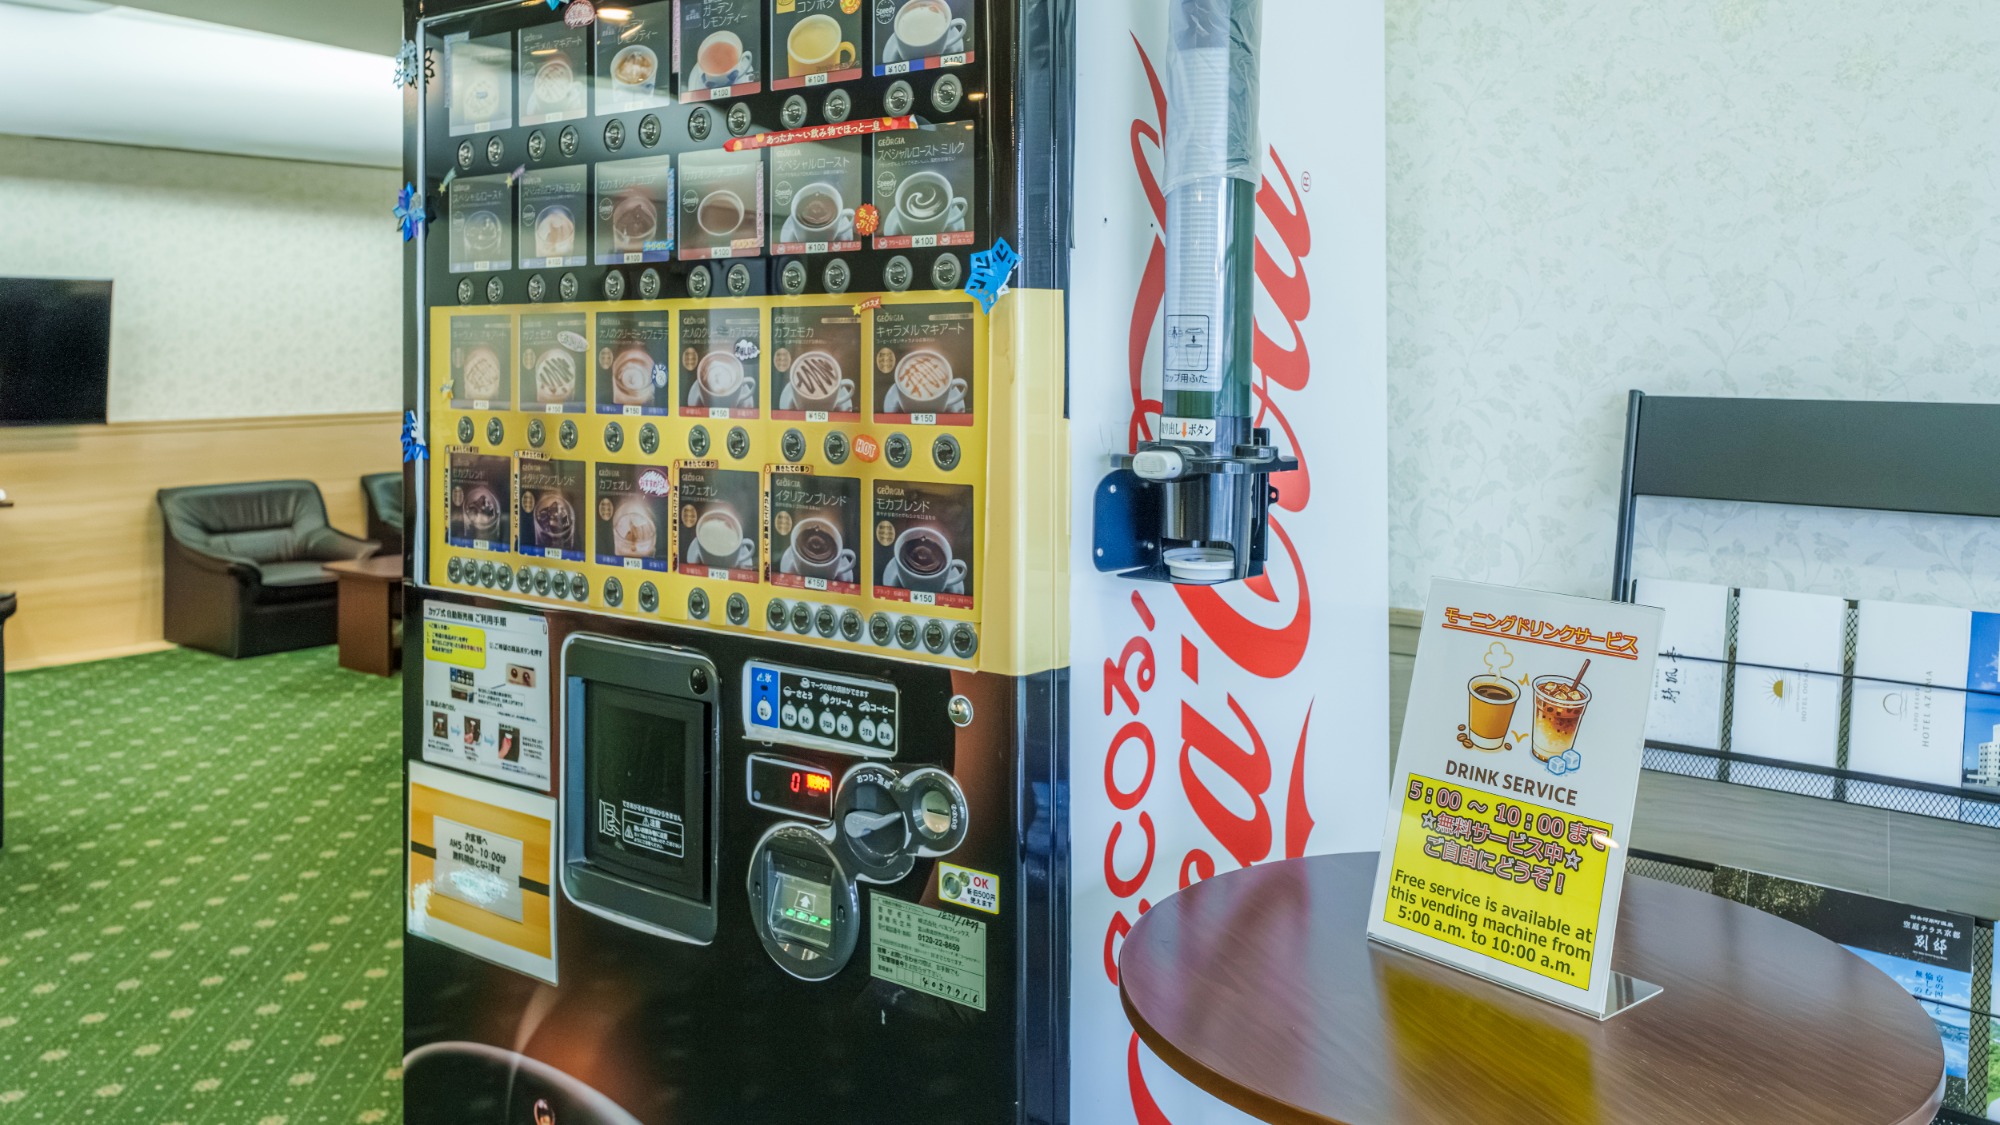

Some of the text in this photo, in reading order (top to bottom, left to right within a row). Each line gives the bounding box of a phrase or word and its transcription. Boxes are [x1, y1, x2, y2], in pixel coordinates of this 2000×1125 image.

[702, 11, 748, 29] レモンティー
[888, 64, 906, 73] ¥100
[807, 75, 825, 83] ¥100
[713, 88, 729, 96] ¥100
[775, 156, 850, 171] スペシャルロースト
[808, 243, 825, 251] ¥100
[914, 237, 934, 246] ¥100
[775, 327, 814, 338] カフェモカ
[711, 410, 727, 418] ¥150
[809, 412, 826, 421] ¥150
[914, 414, 934, 423] ¥150
[1188, 423, 1213, 437] ボタン
[855, 437, 877, 459] HOT
[599, 479, 632, 491] カフェオレ
[681, 484, 718, 497] カフェオレ
[775, 489, 847, 507] イタリアンブレンド
[876, 498, 931, 513] モカブレンド
[710, 571, 727, 580] ¥150
[807, 579, 825, 588] ¥150
[913, 593, 933, 602] ¥150
[1445, 607, 1638, 654] モーニングドリンクサービス
[764, 673, 772, 683] 氷
[796, 690, 813, 700] さとう
[829, 697, 854, 708] クリーム
[870, 704, 895, 714] コーヒー
[1922, 713, 1932, 748] HOTEL
[790, 772, 801, 793] 0
[1445, 759, 1578, 806] DRINK SERVICE
[465, 832, 488, 845] お客様へ
[1568, 822, 1610, 851] まで
[1424, 835, 1565, 895] ご自由にどうぞ！
[973, 876, 989, 890] OK
[967, 887, 996, 901] 新旧500円
[970, 896, 993, 908] 使えます
[1394, 868, 1593, 944] Free service is available at
[1390, 885, 1592, 963] this vending machine from
[1397, 905, 1576, 977] 5:00 a.m. to 10:00 a.m.
[1914, 934, 1948, 955] 別邸
